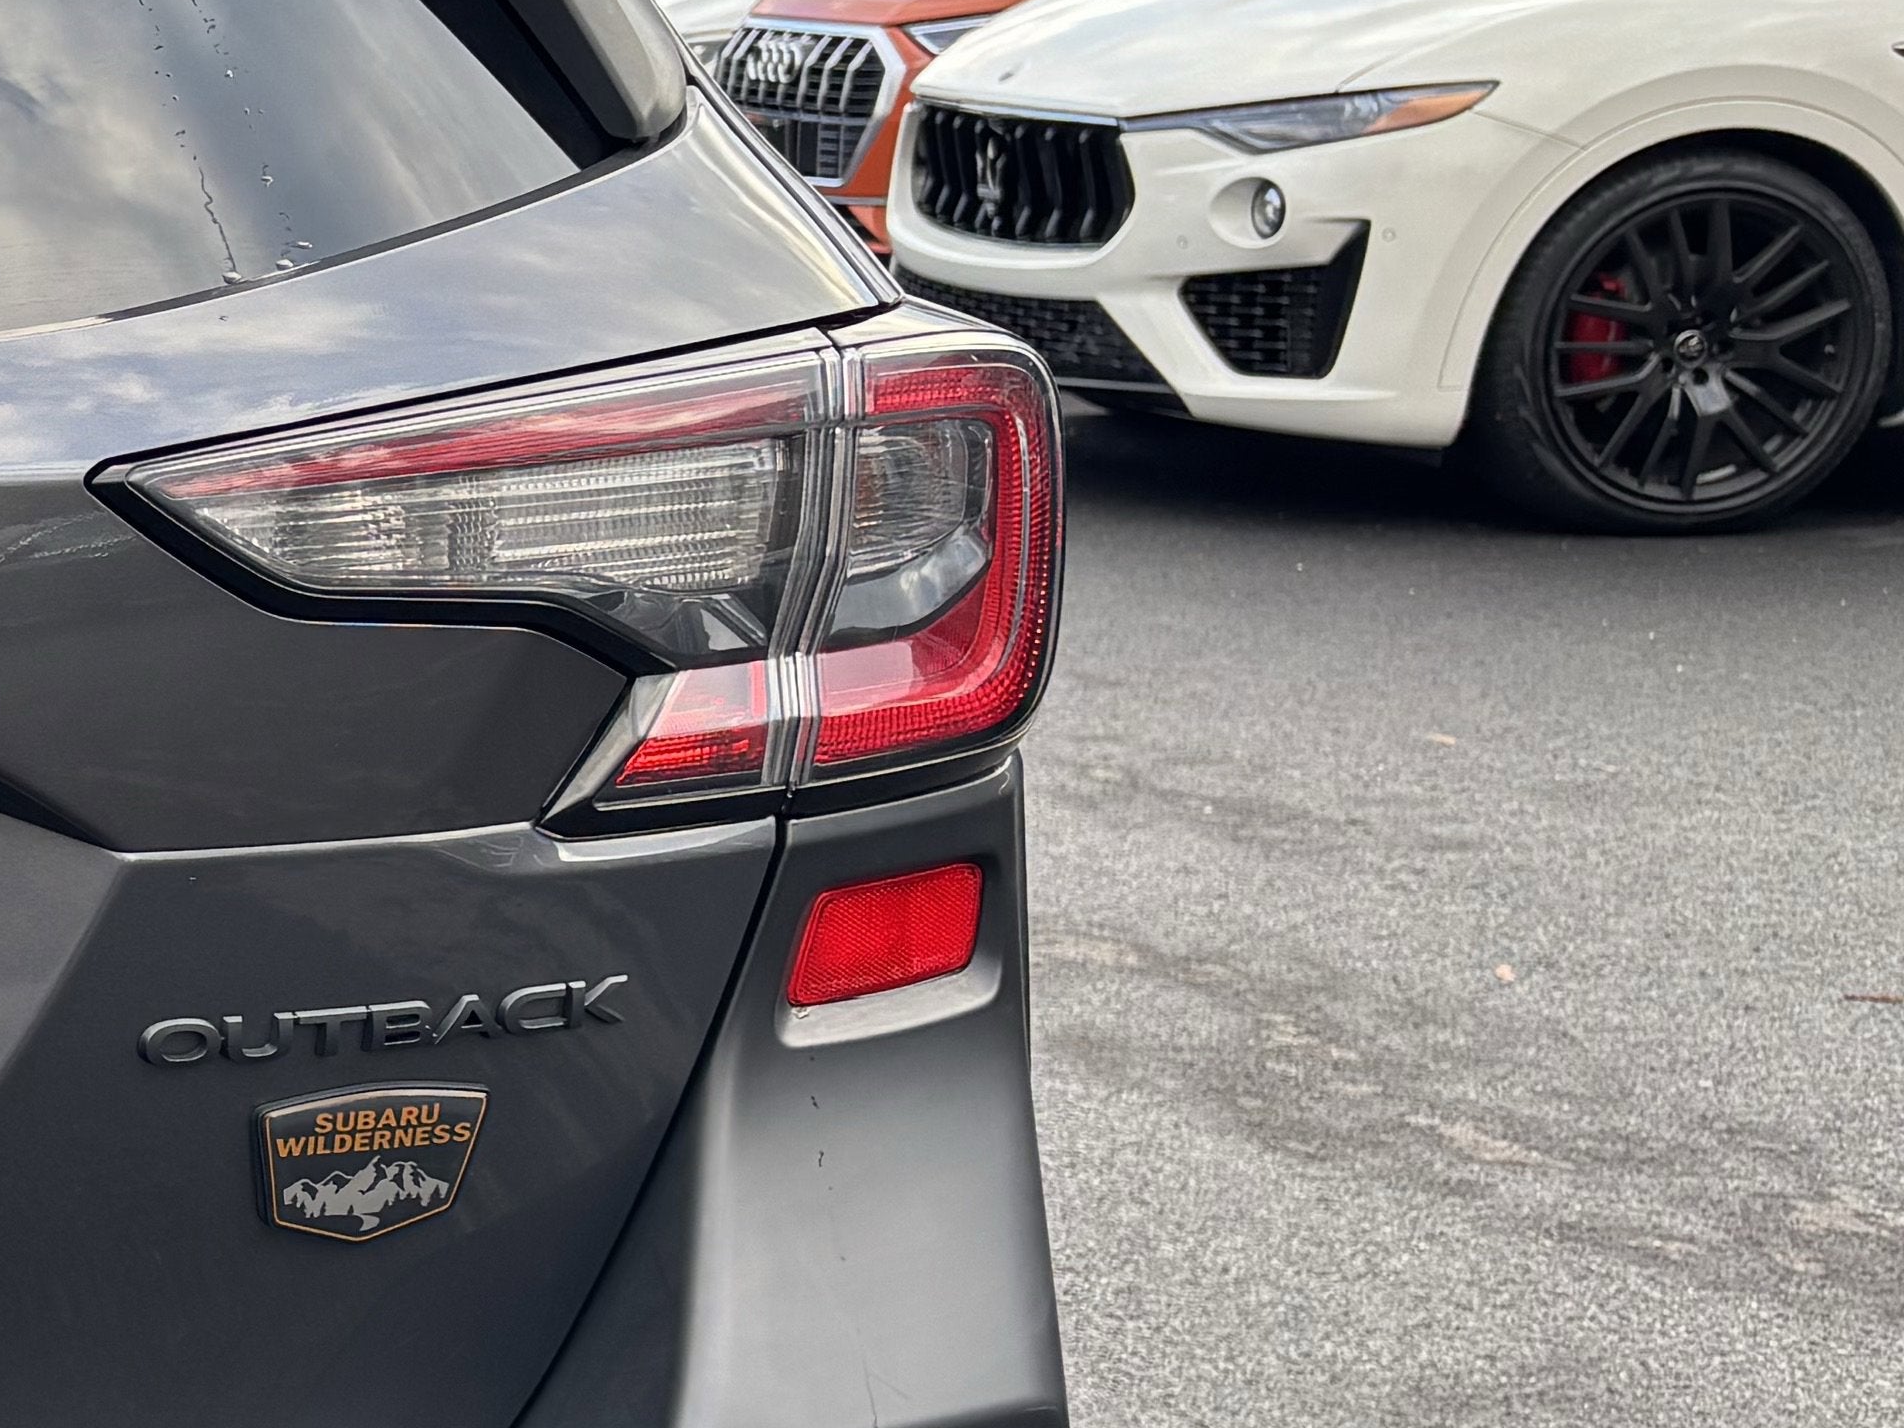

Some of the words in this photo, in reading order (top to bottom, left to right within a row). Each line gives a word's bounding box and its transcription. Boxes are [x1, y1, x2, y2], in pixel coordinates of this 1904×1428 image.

[137, 974, 628, 1067] OUTBACK
[313, 1103, 441, 1134] SUBARU
[275, 1122, 472, 1158] WILDERNESS
